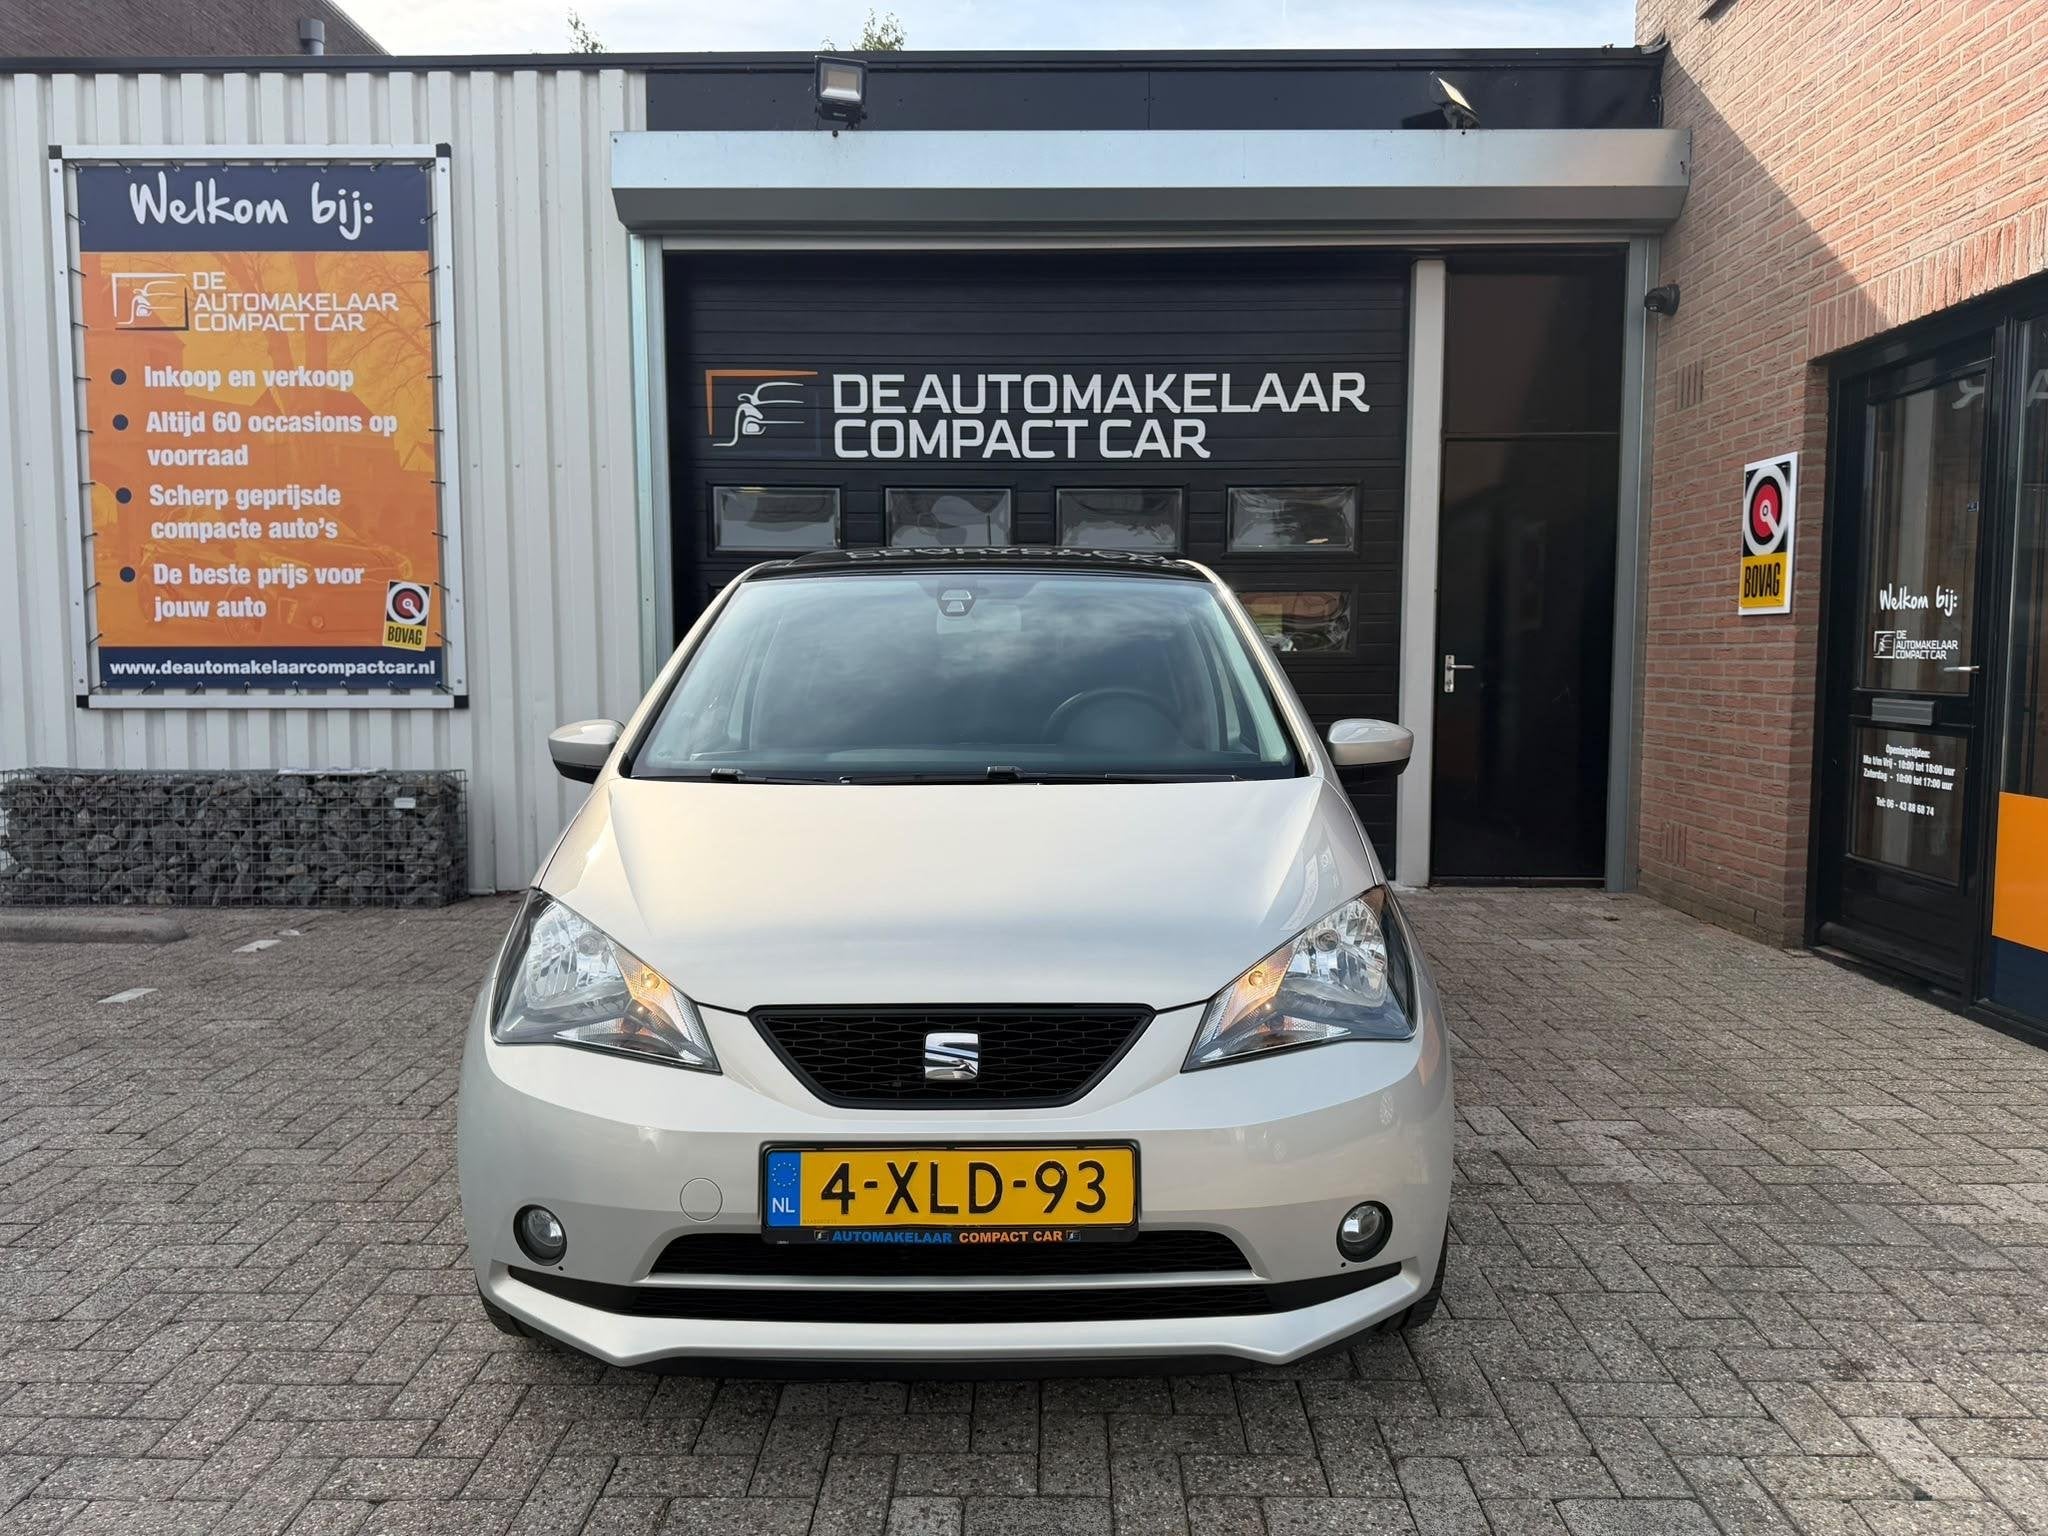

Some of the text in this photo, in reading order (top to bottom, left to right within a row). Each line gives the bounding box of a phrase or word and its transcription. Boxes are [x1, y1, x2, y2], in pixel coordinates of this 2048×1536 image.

[129, 171, 374, 240] Welkom bij:
[192, 271, 226, 291] DE
[193, 292, 399, 312] AUTOMAKELAAR
[195, 313, 366, 332] COMPACT CAR
[144, 366, 354, 391] Inkoop en verkoop
[833, 373, 1370, 414] DE AUTOMAKELAAR
[146, 411, 397, 438] Altijd 60 occasions op
[833, 418, 1211, 459] COMPACT CAR
[147, 445, 249, 466] voorraad
[149, 485, 341, 511] Scherp geprijsde
[150, 518, 262, 543] compacte
[153, 563, 364, 589] De beste prijs voor
[1744, 562, 1781, 599] BOVAG
[153, 597, 267, 622] jouw auto
[1879, 583, 1958, 617] Welkom bij:
[387, 625, 423, 646] BOVAG
[1896, 630, 1907, 639] DE
[1896, 640, 1958, 650] AUTOMAKELAAR
[1896, 650, 1947, 660] COMPACT CAR
[110, 659, 436, 677] www.deautomakelaarcompactcar.nl
[1885, 743, 1931, 758] Openingstijden:
[1863, 755, 1872, 764] Ma
[1883, 757, 1893, 769] Vrij
[1915, 763, 1925, 772] tot
[1943, 767, 1956, 776] uur
[1863, 768, 1888, 782] Zaterdag
[1913, 776, 1922, 786] tot
[1923, 777, 1941, 788] 17:00
[1941, 781, 1954, 791] uur
[1926, 806, 1935, 816] 74
[819, 1159, 1107, 1215] 4-XLD-93
[772, 1197, 796, 1214] NL
[832, 1230, 1063, 1244] AUTOMAKELAAR COMPACT CAR
